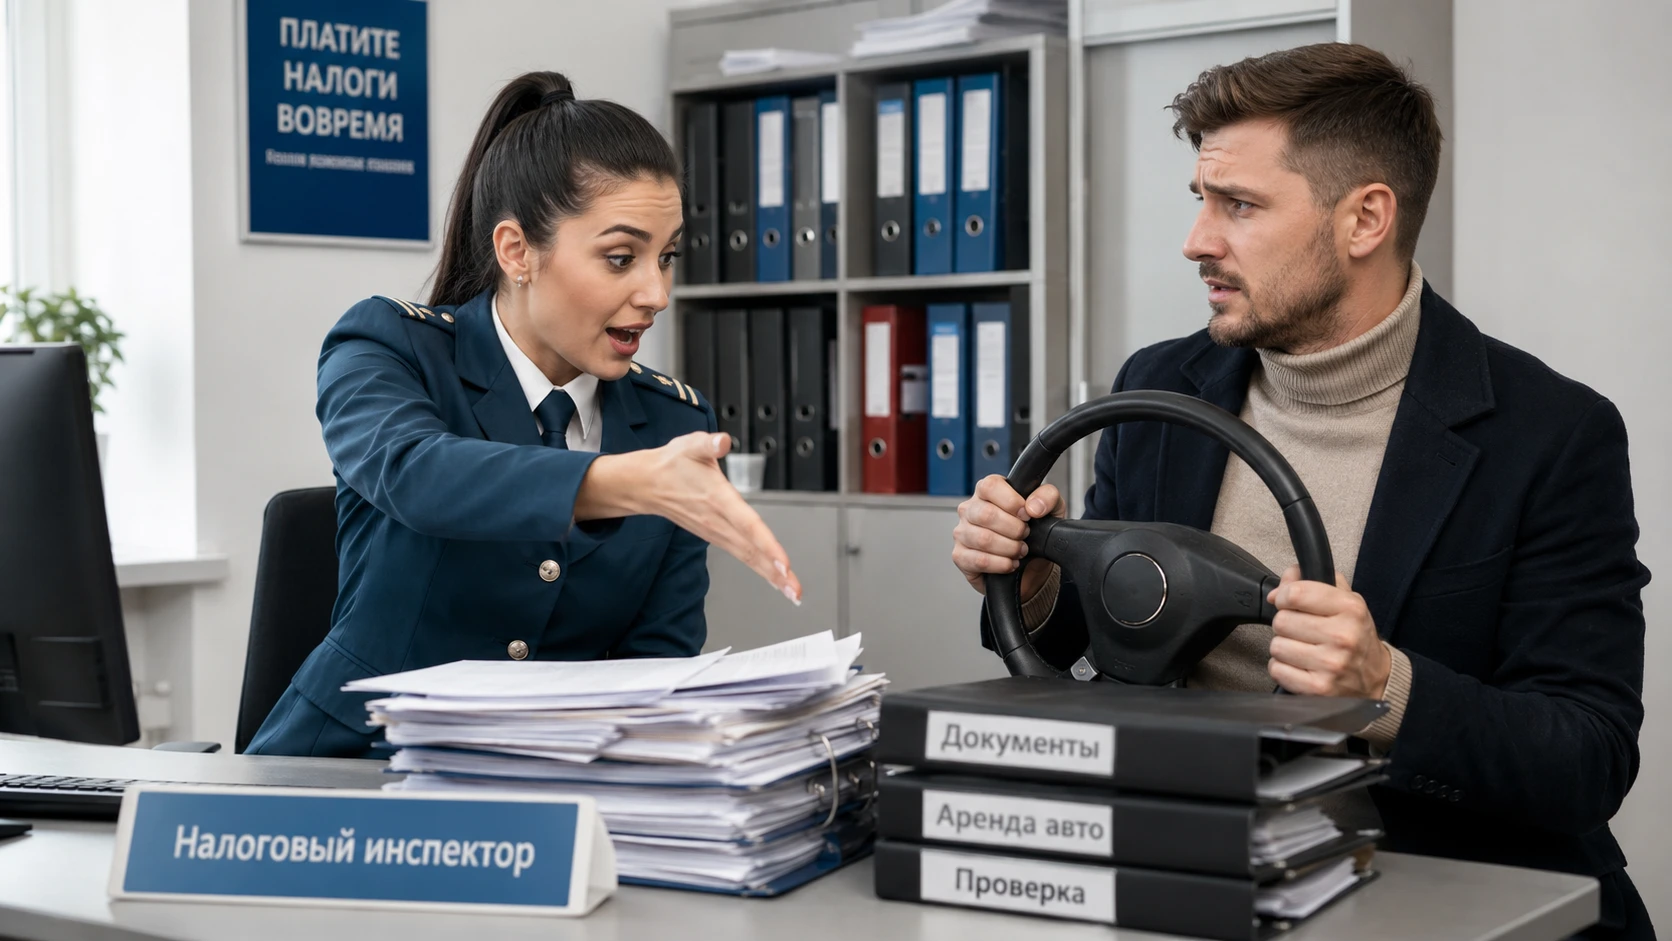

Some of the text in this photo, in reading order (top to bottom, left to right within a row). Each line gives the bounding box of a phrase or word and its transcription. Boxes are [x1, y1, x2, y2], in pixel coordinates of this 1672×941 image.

[280, 17, 400, 59] ПЛАТИТЕ
[284, 60, 397, 100] НАЛОГИ
[277, 103, 403, 142] ВОВРЕМЯ
[941, 724, 1099, 759] Документы
[936, 803, 1104, 840] Аренда авто
[173, 824, 535, 877] Налоговый инспектор
[955, 868, 1086, 905] Проверка
